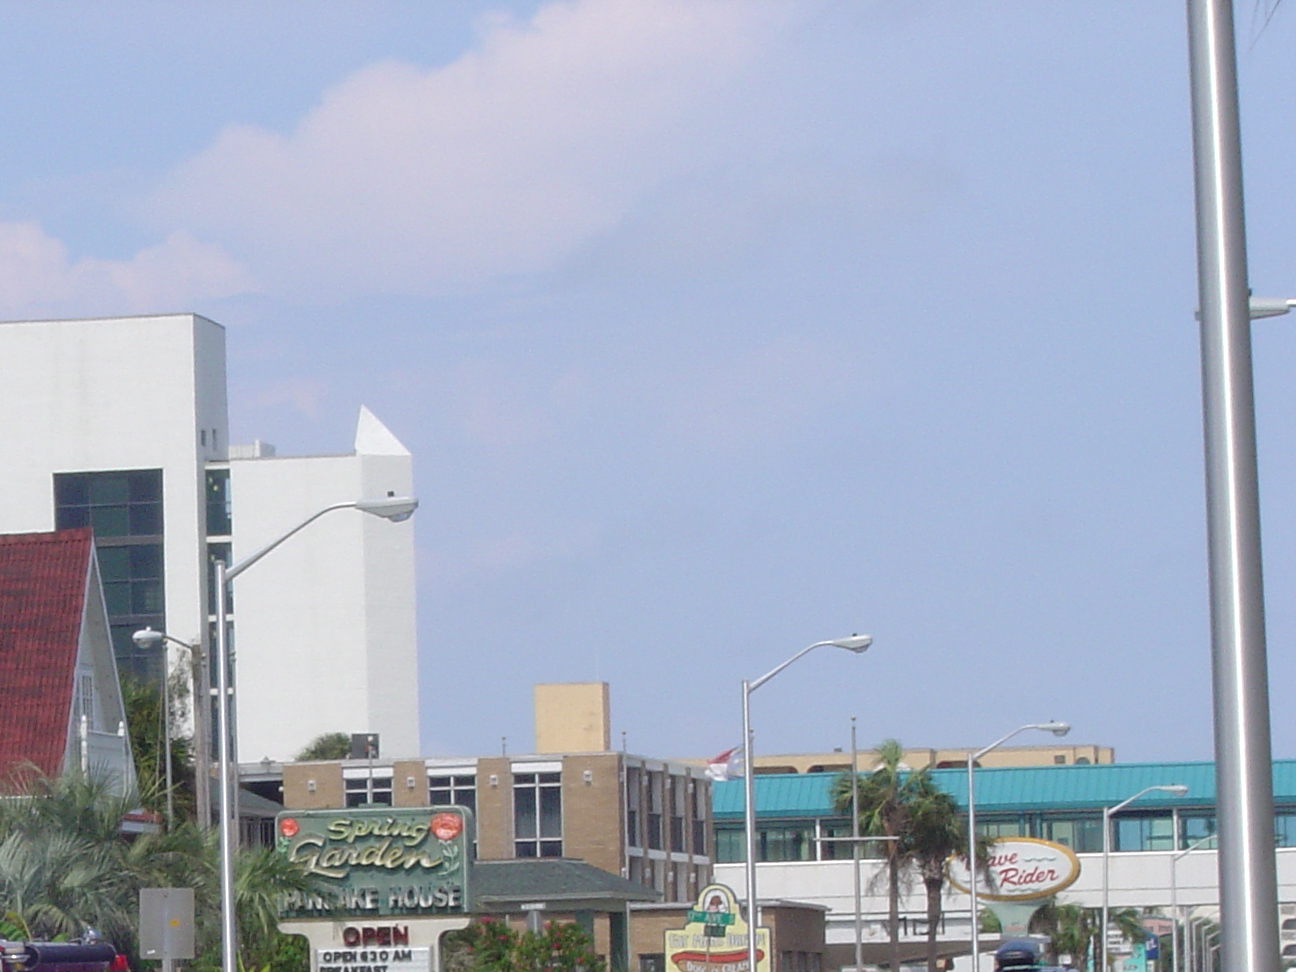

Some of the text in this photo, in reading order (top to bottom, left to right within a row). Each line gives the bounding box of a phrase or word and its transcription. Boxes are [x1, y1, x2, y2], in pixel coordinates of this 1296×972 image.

[327, 817, 431, 847] Spring
[288, 832, 443, 879] Garden
[999, 866, 1059, 888] Rider
[389, 883, 461, 909] HOUSE
[343, 926, 409, 947] OPEN
[323, 951, 357, 962] OPEN
[393, 950, 412, 961] AM
